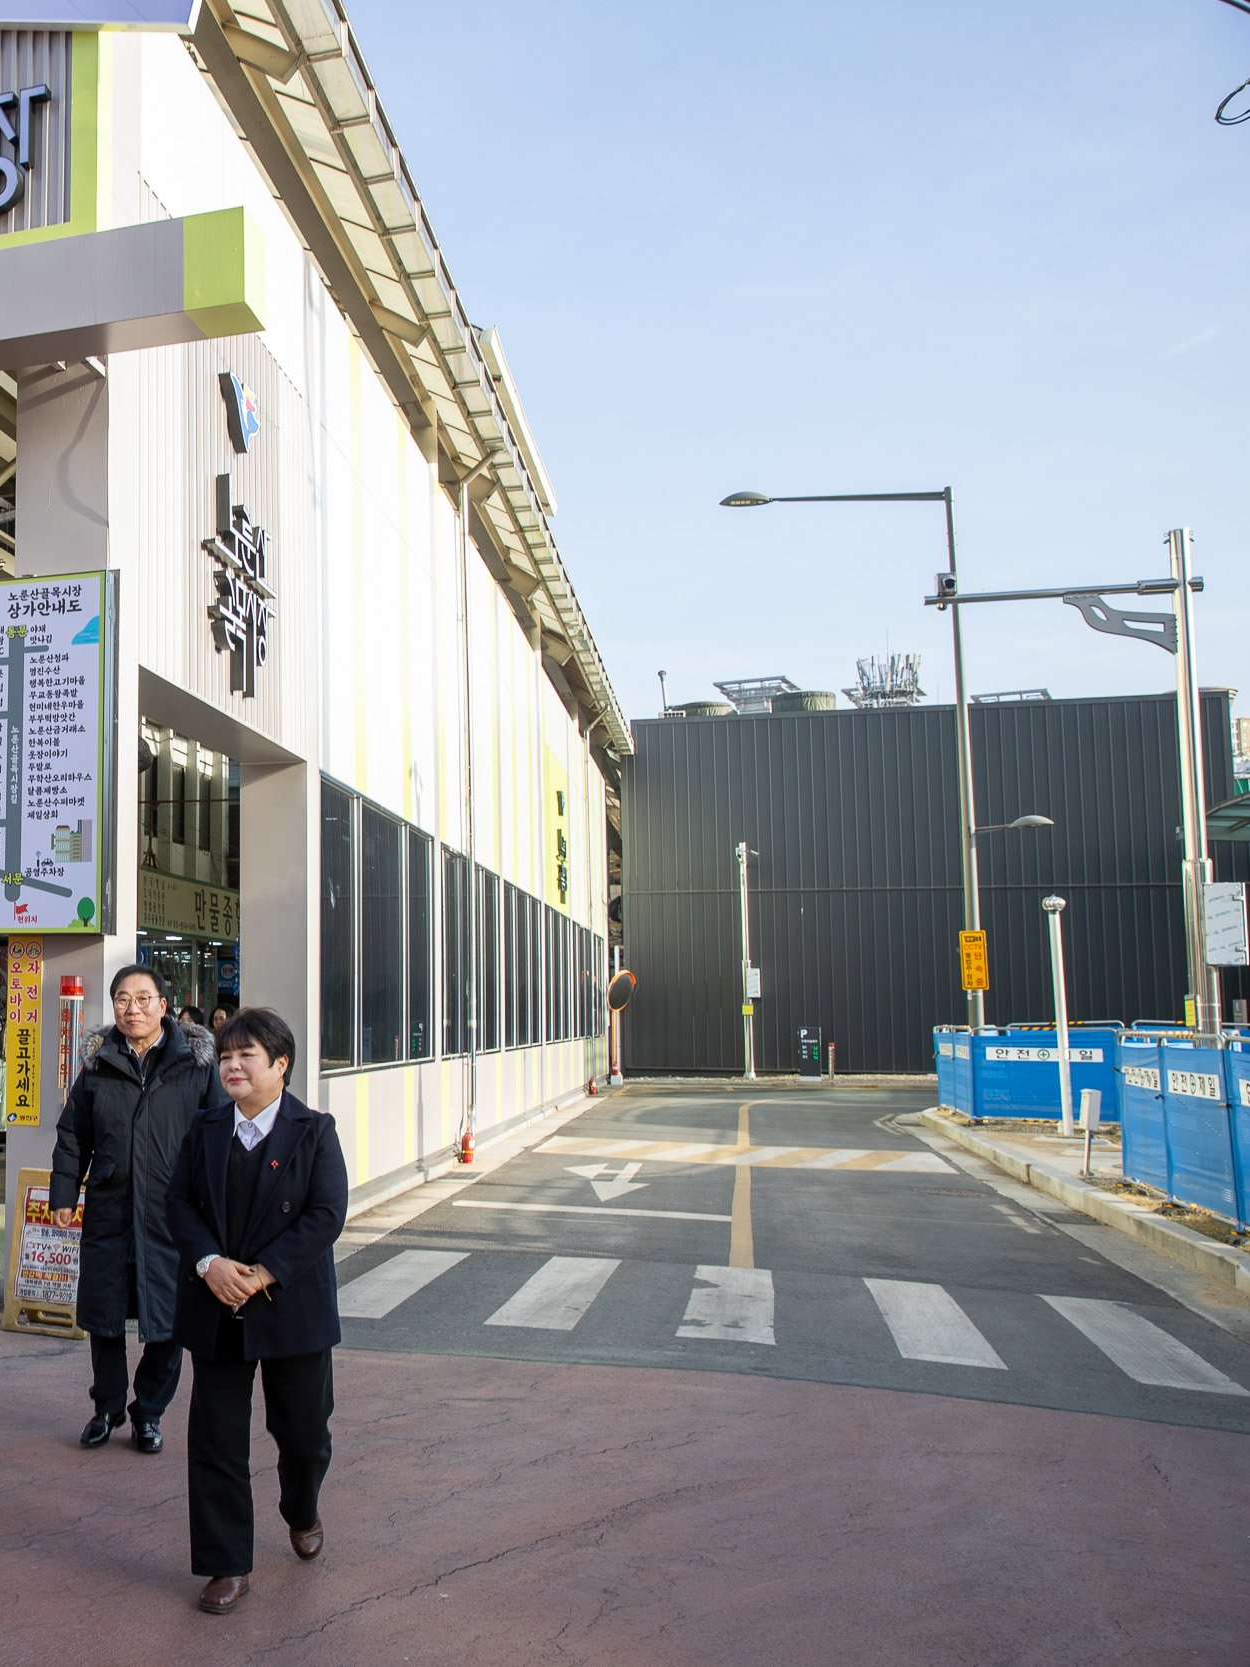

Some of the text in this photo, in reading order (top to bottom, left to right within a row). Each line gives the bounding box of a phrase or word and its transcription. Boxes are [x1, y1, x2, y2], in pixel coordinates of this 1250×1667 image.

[201, 473, 277, 599] 노룬산
[8, 584, 82, 601] 노룬산골목시장
[7, 599, 82, 619] 상가안내도
[6, 625, 28, 639] 동문
[30, 624, 46, 633] 야채
[207, 565, 276, 699] 골목시장
[30, 634, 52, 645] 맛나김
[30, 676, 85, 688] 행복한고기마을
[29, 712, 75, 724] 부부떡방앗간
[28, 724, 85, 735] 노룬산금거래소
[28, 737, 60, 747] 한복이불
[28, 749, 68, 760] 옷장이야기
[28, 772, 92, 783] 무학산오리하우스
[27, 809, 58, 820] 제일상회
[24, 867, 65, 877] 공영주차장
[1, 872, 24, 886] 서문
[17, 915, 38, 924] 현위치
[9, 962, 23, 1024] 오토바이
[26, 960, 40, 1025] 자전거
[801, 1029, 807, 1038] P
[995, 1048, 1030, 1060] 안전
[15, 1028, 31, 1108] 끌고가세요
[1171, 1072, 1215, 1097] 안전 제일
[31, 1250, 72, 1266] 16,500
